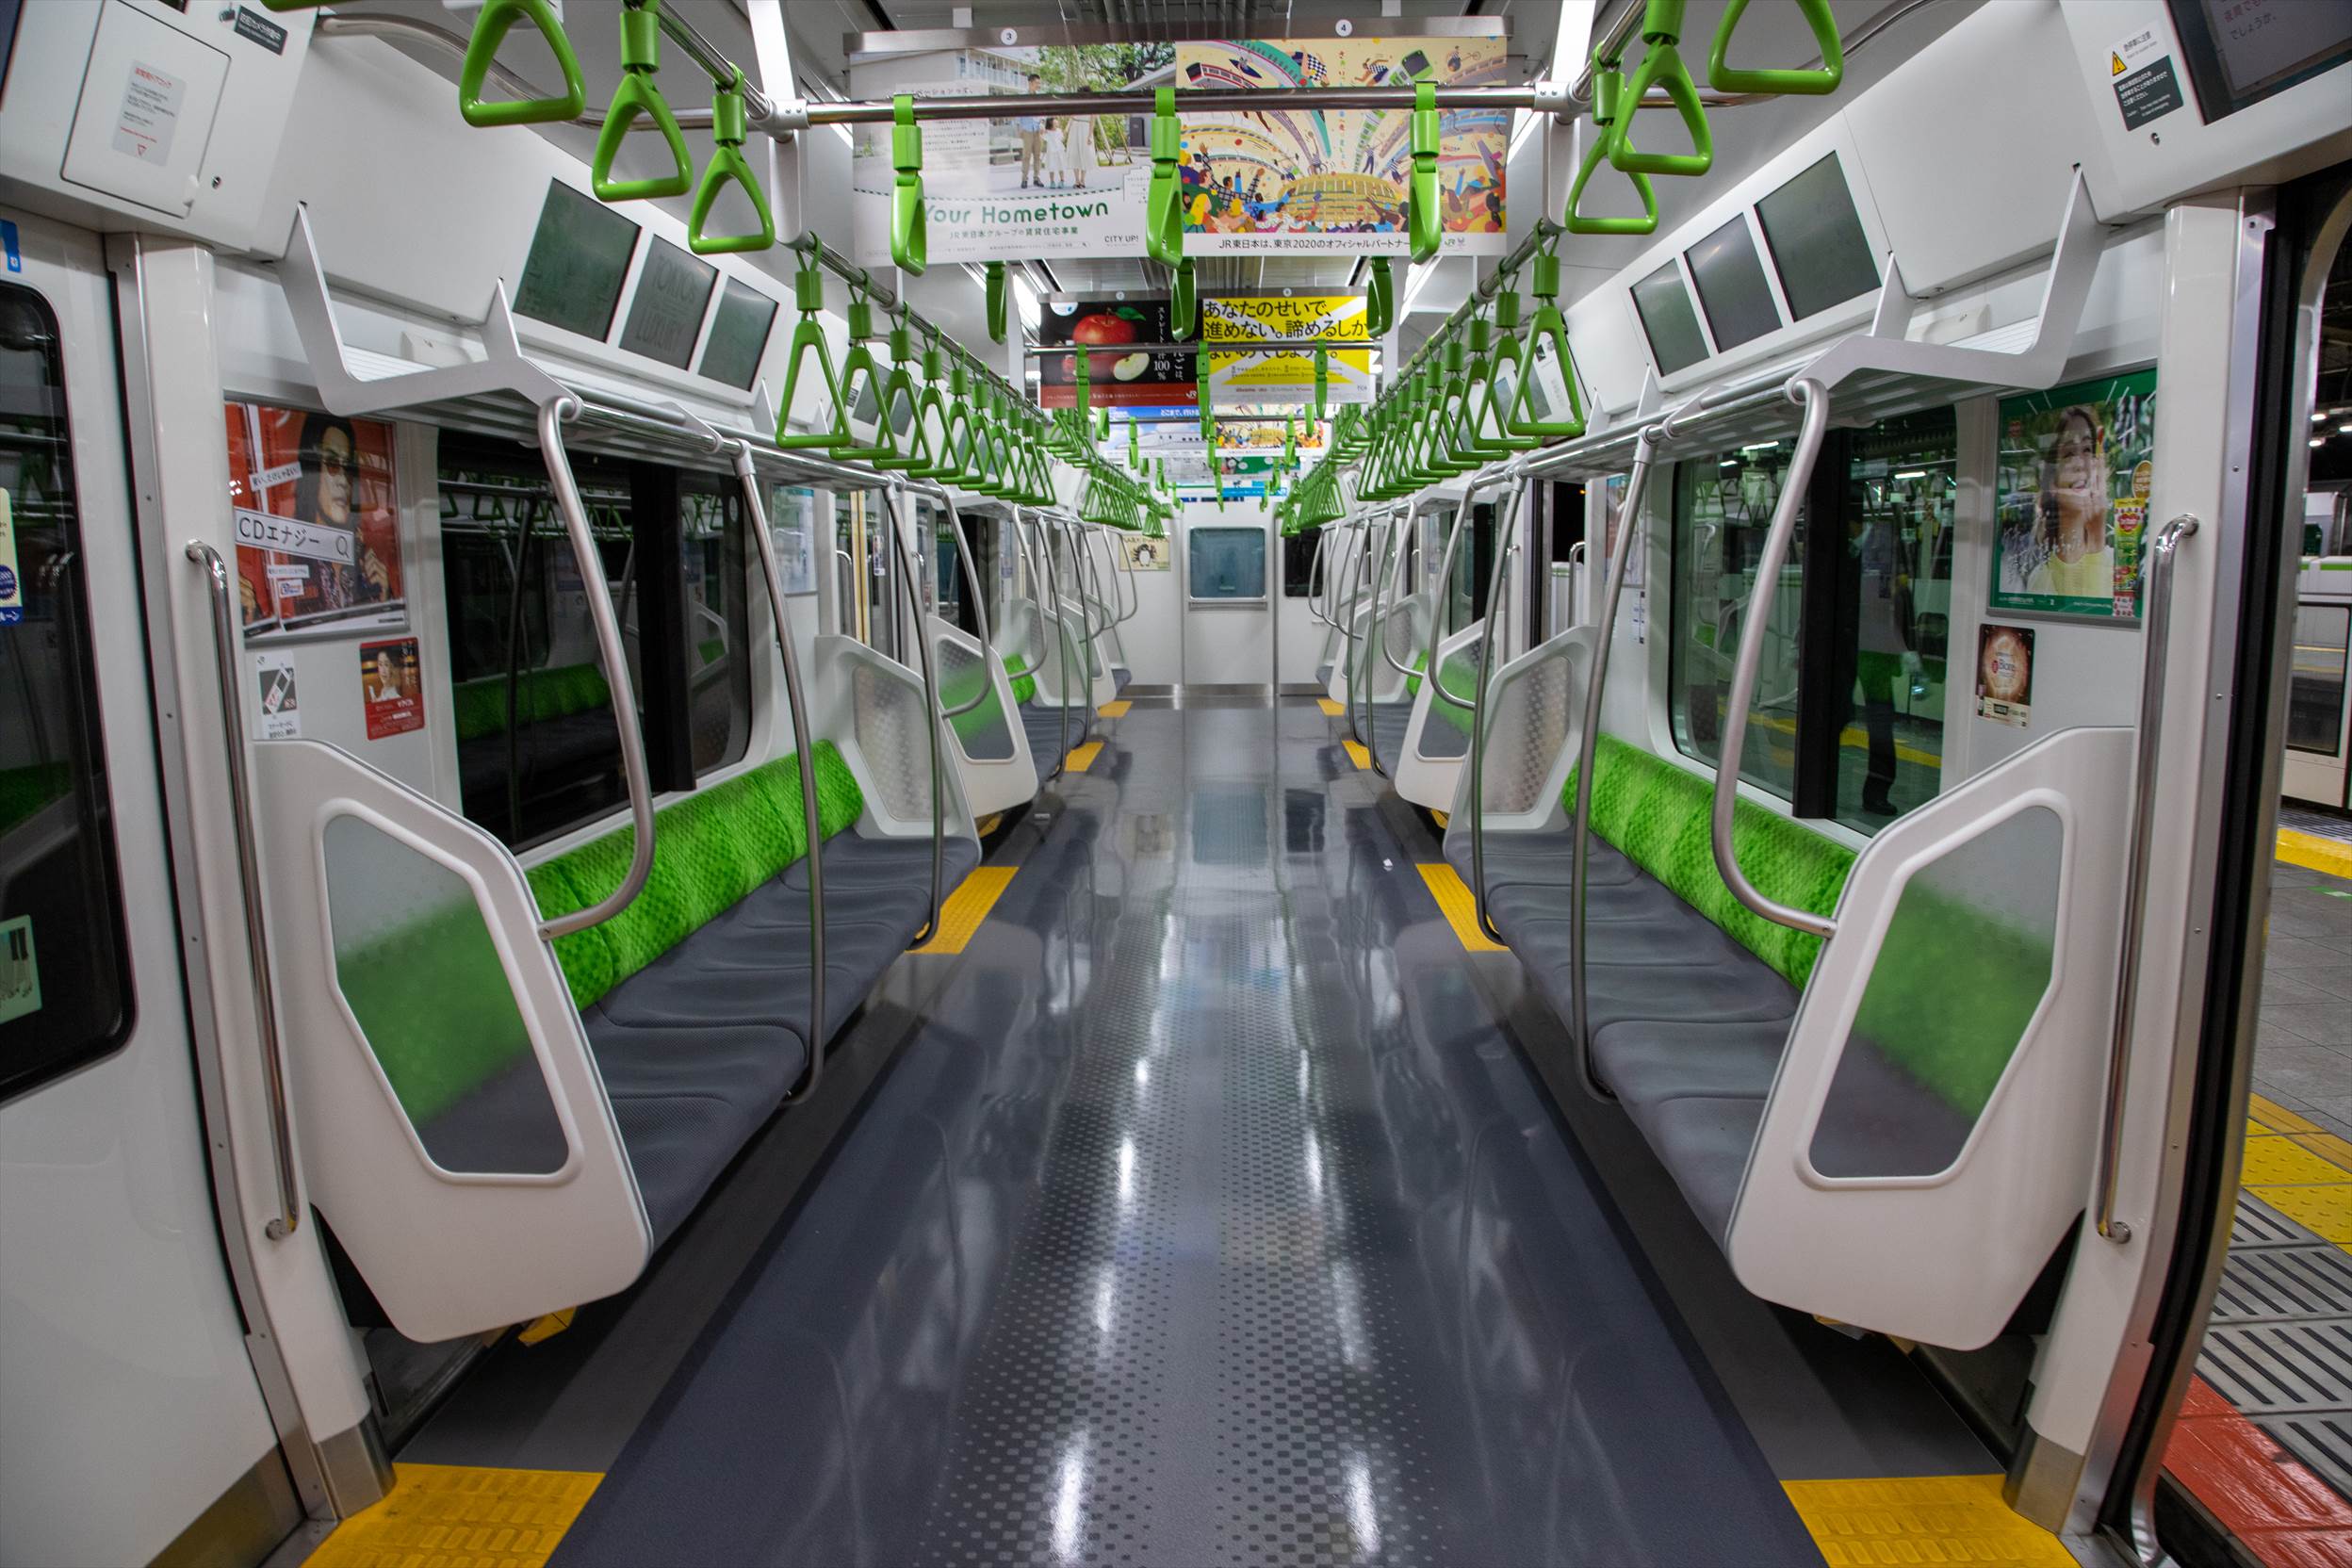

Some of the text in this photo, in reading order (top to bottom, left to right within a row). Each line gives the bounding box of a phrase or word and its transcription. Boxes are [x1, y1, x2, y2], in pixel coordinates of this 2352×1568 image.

[925, 202, 1109, 223] Your Hometown
[1204, 300, 1331, 318] あなたのせいで、
[1205, 320, 1367, 339] 進めない。諦めるしか
[238, 516, 319, 547] CDエナジー
